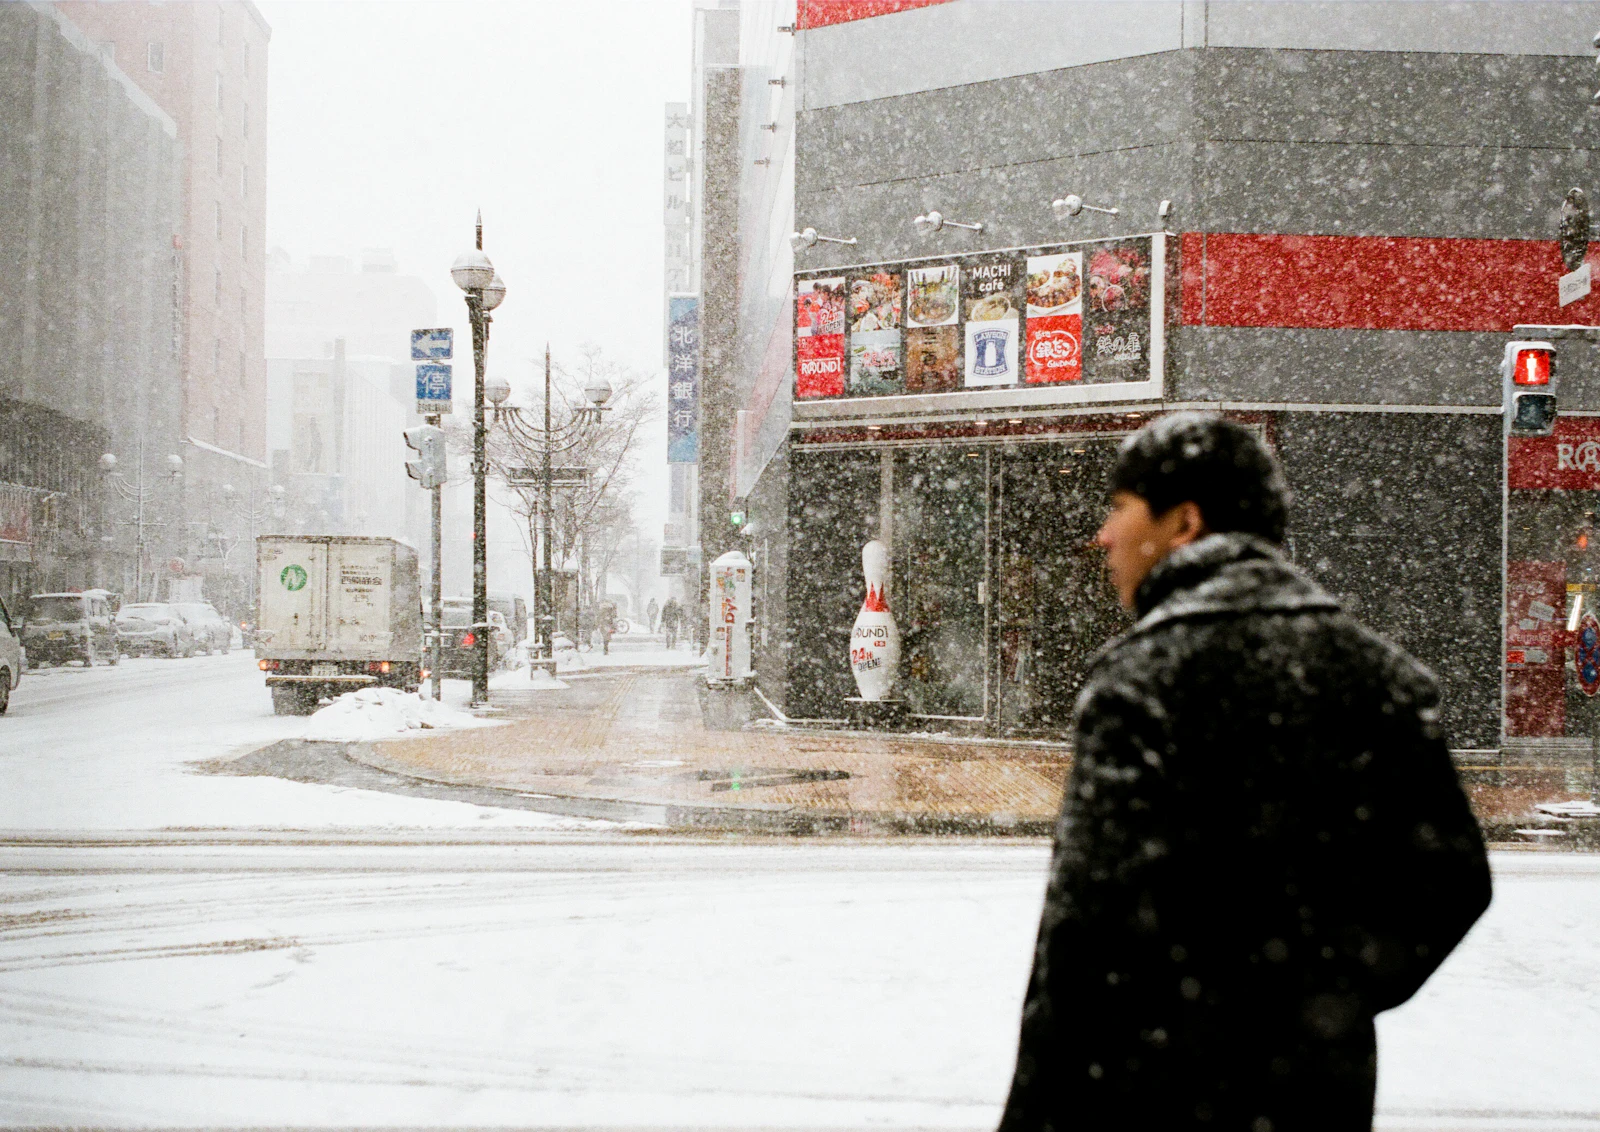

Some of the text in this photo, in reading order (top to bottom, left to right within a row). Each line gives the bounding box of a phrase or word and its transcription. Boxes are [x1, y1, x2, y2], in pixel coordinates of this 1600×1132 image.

[972, 264, 1012, 280] MACHI
[978, 279, 1005, 292] café
[801, 357, 841, 375] ROUND1
[421, 371, 448, 395] 停
[672, 326, 694, 428] 北洋銀行
